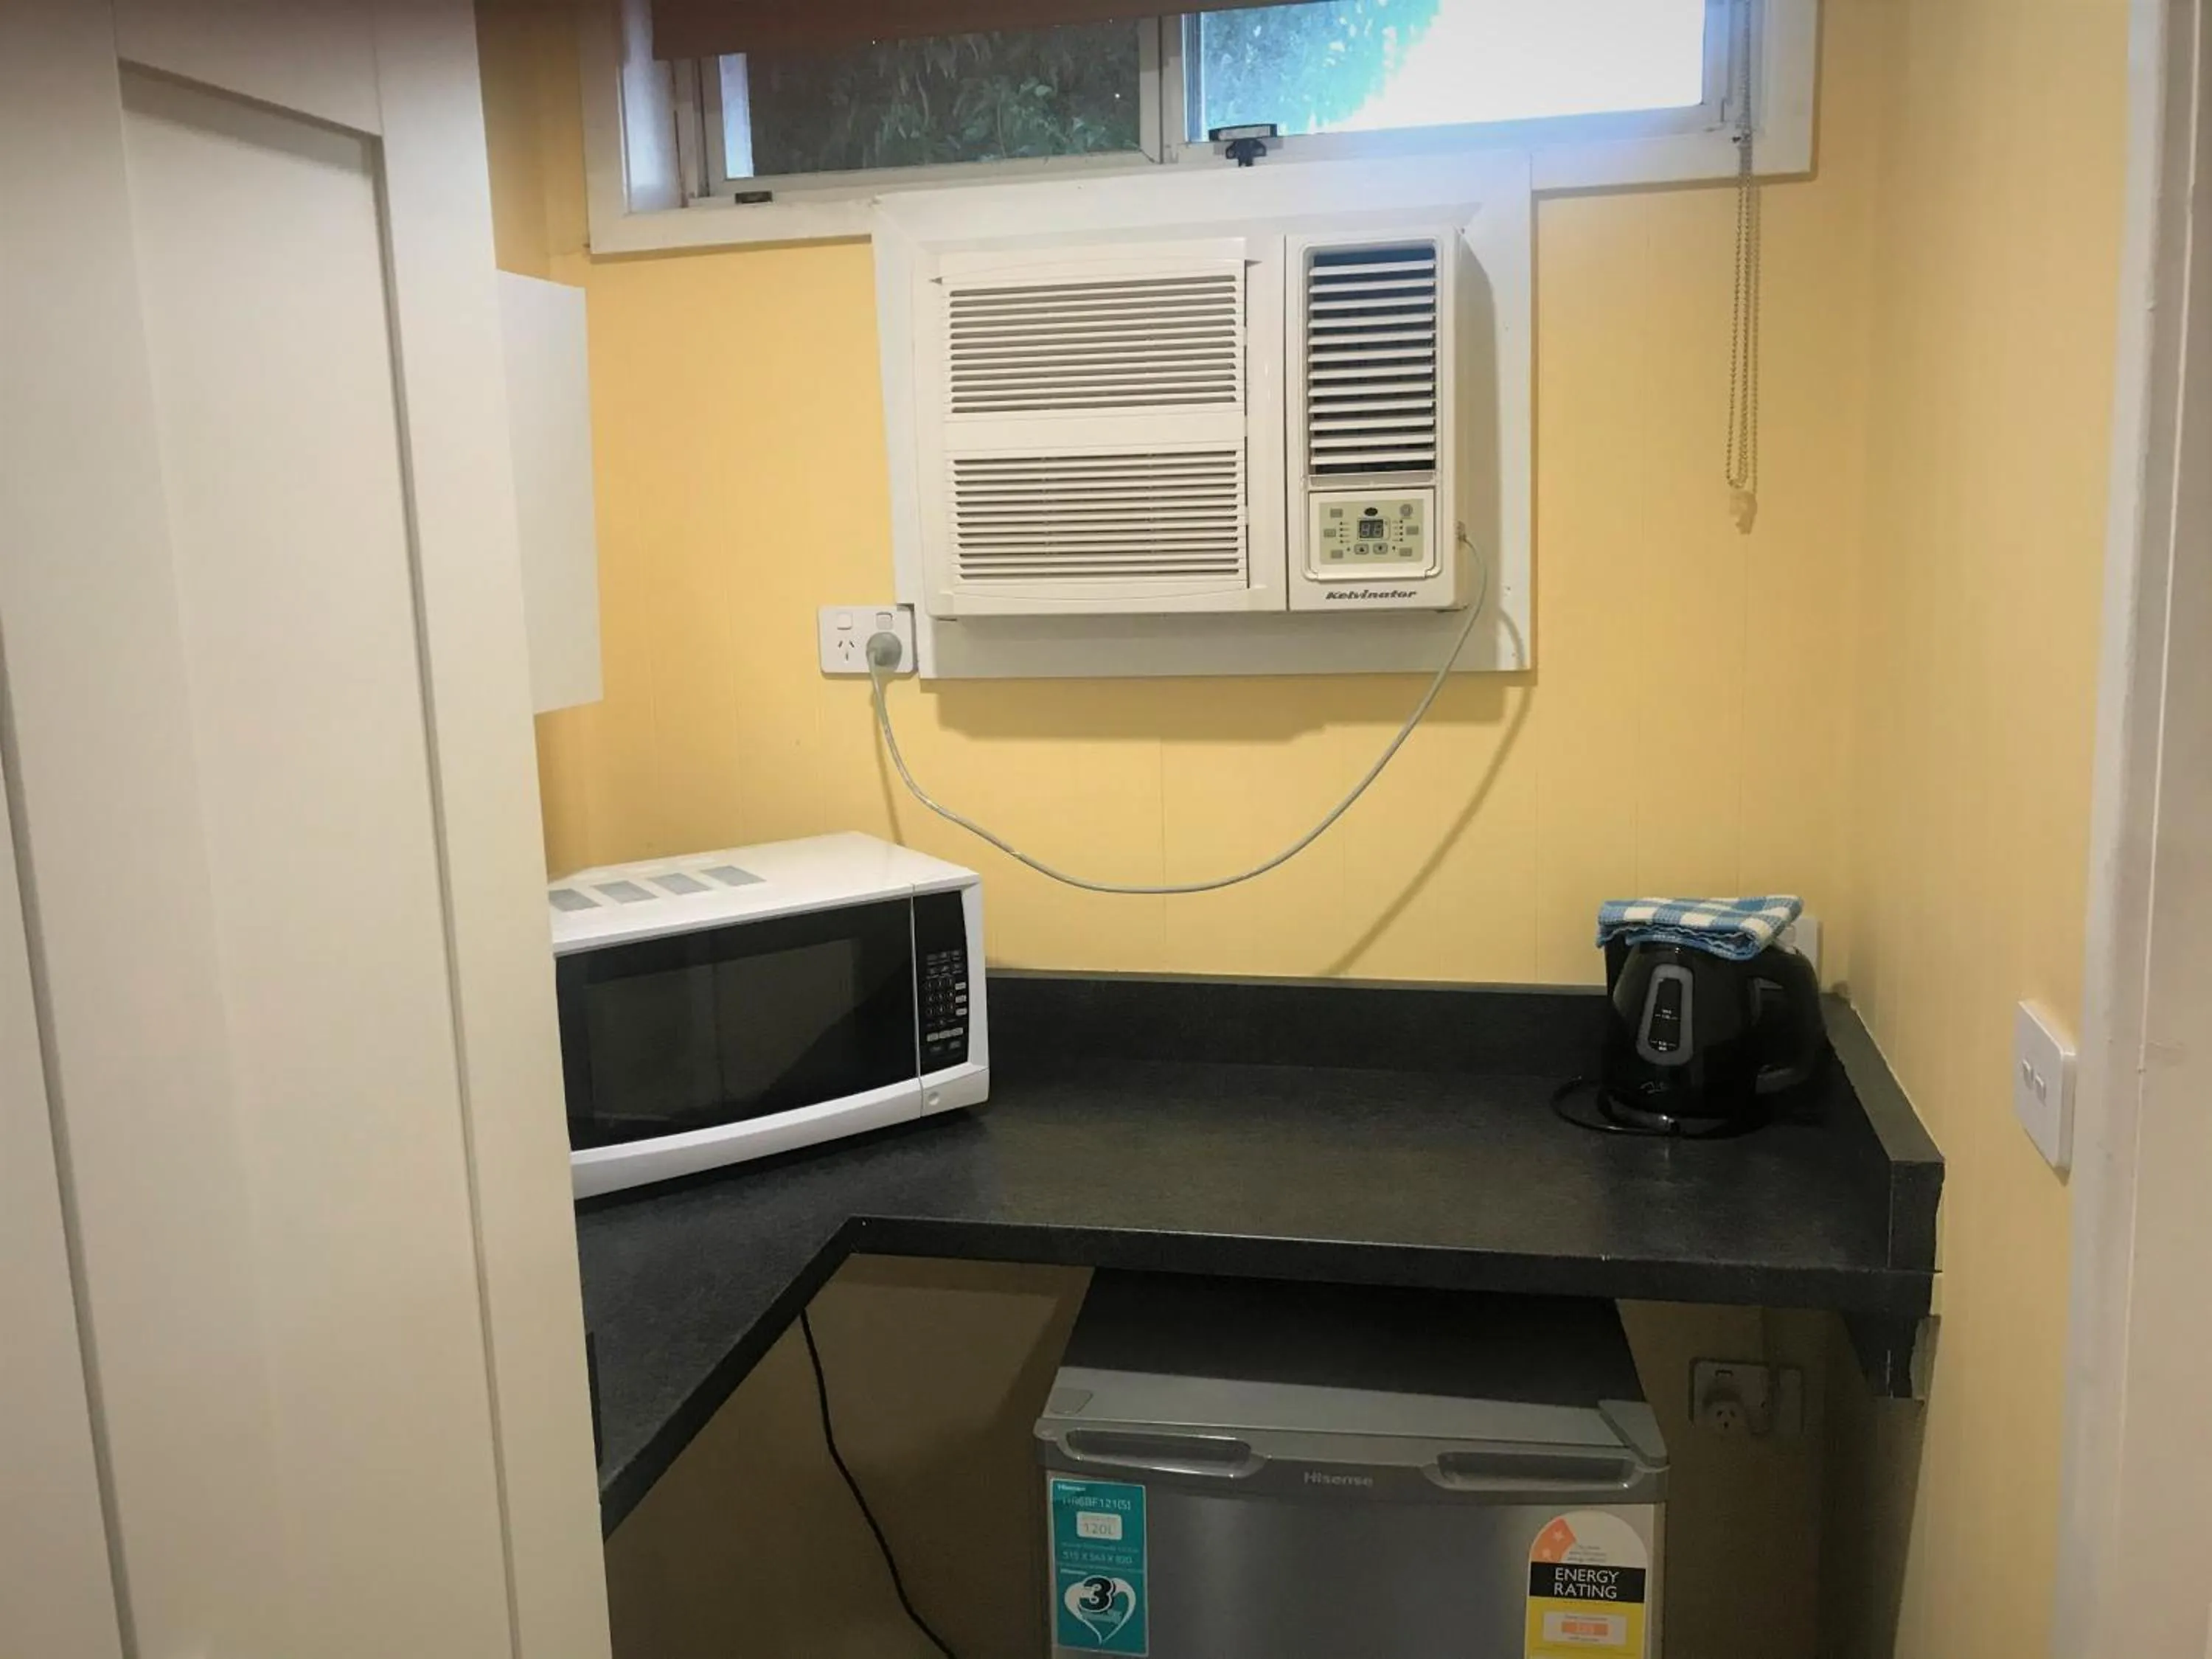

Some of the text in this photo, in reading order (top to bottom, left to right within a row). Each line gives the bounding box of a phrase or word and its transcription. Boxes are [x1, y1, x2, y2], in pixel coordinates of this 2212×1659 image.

[1326, 590, 1416, 600] Kelvinator
[1304, 1471, 1373, 1486] Hisense
[1554, 1567, 1619, 1584] ENERGY
[1079, 1576, 1116, 1613] 3
[1554, 1582, 1617, 1599] RATING
